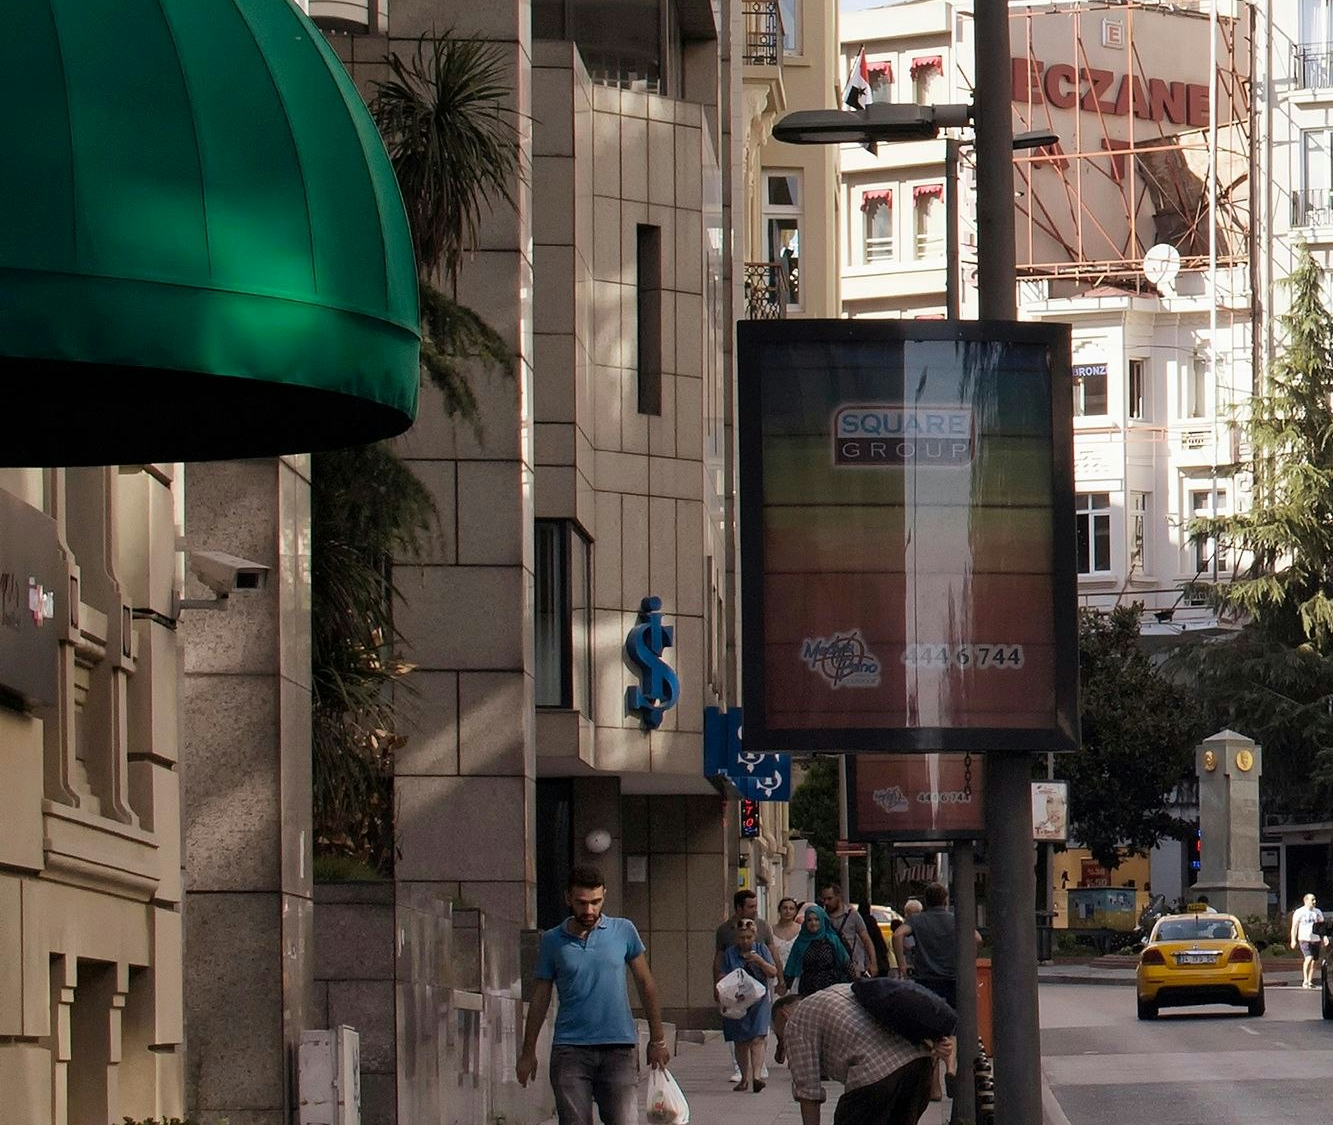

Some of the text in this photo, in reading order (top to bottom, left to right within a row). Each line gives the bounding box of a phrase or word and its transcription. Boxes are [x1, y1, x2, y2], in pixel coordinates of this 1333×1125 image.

[1011, 57, 1211, 127] ECZANE
[842, 414, 966, 434] SQUARE
[842, 442, 967, 458] GROUP
[977, 648, 1021, 665] 744
